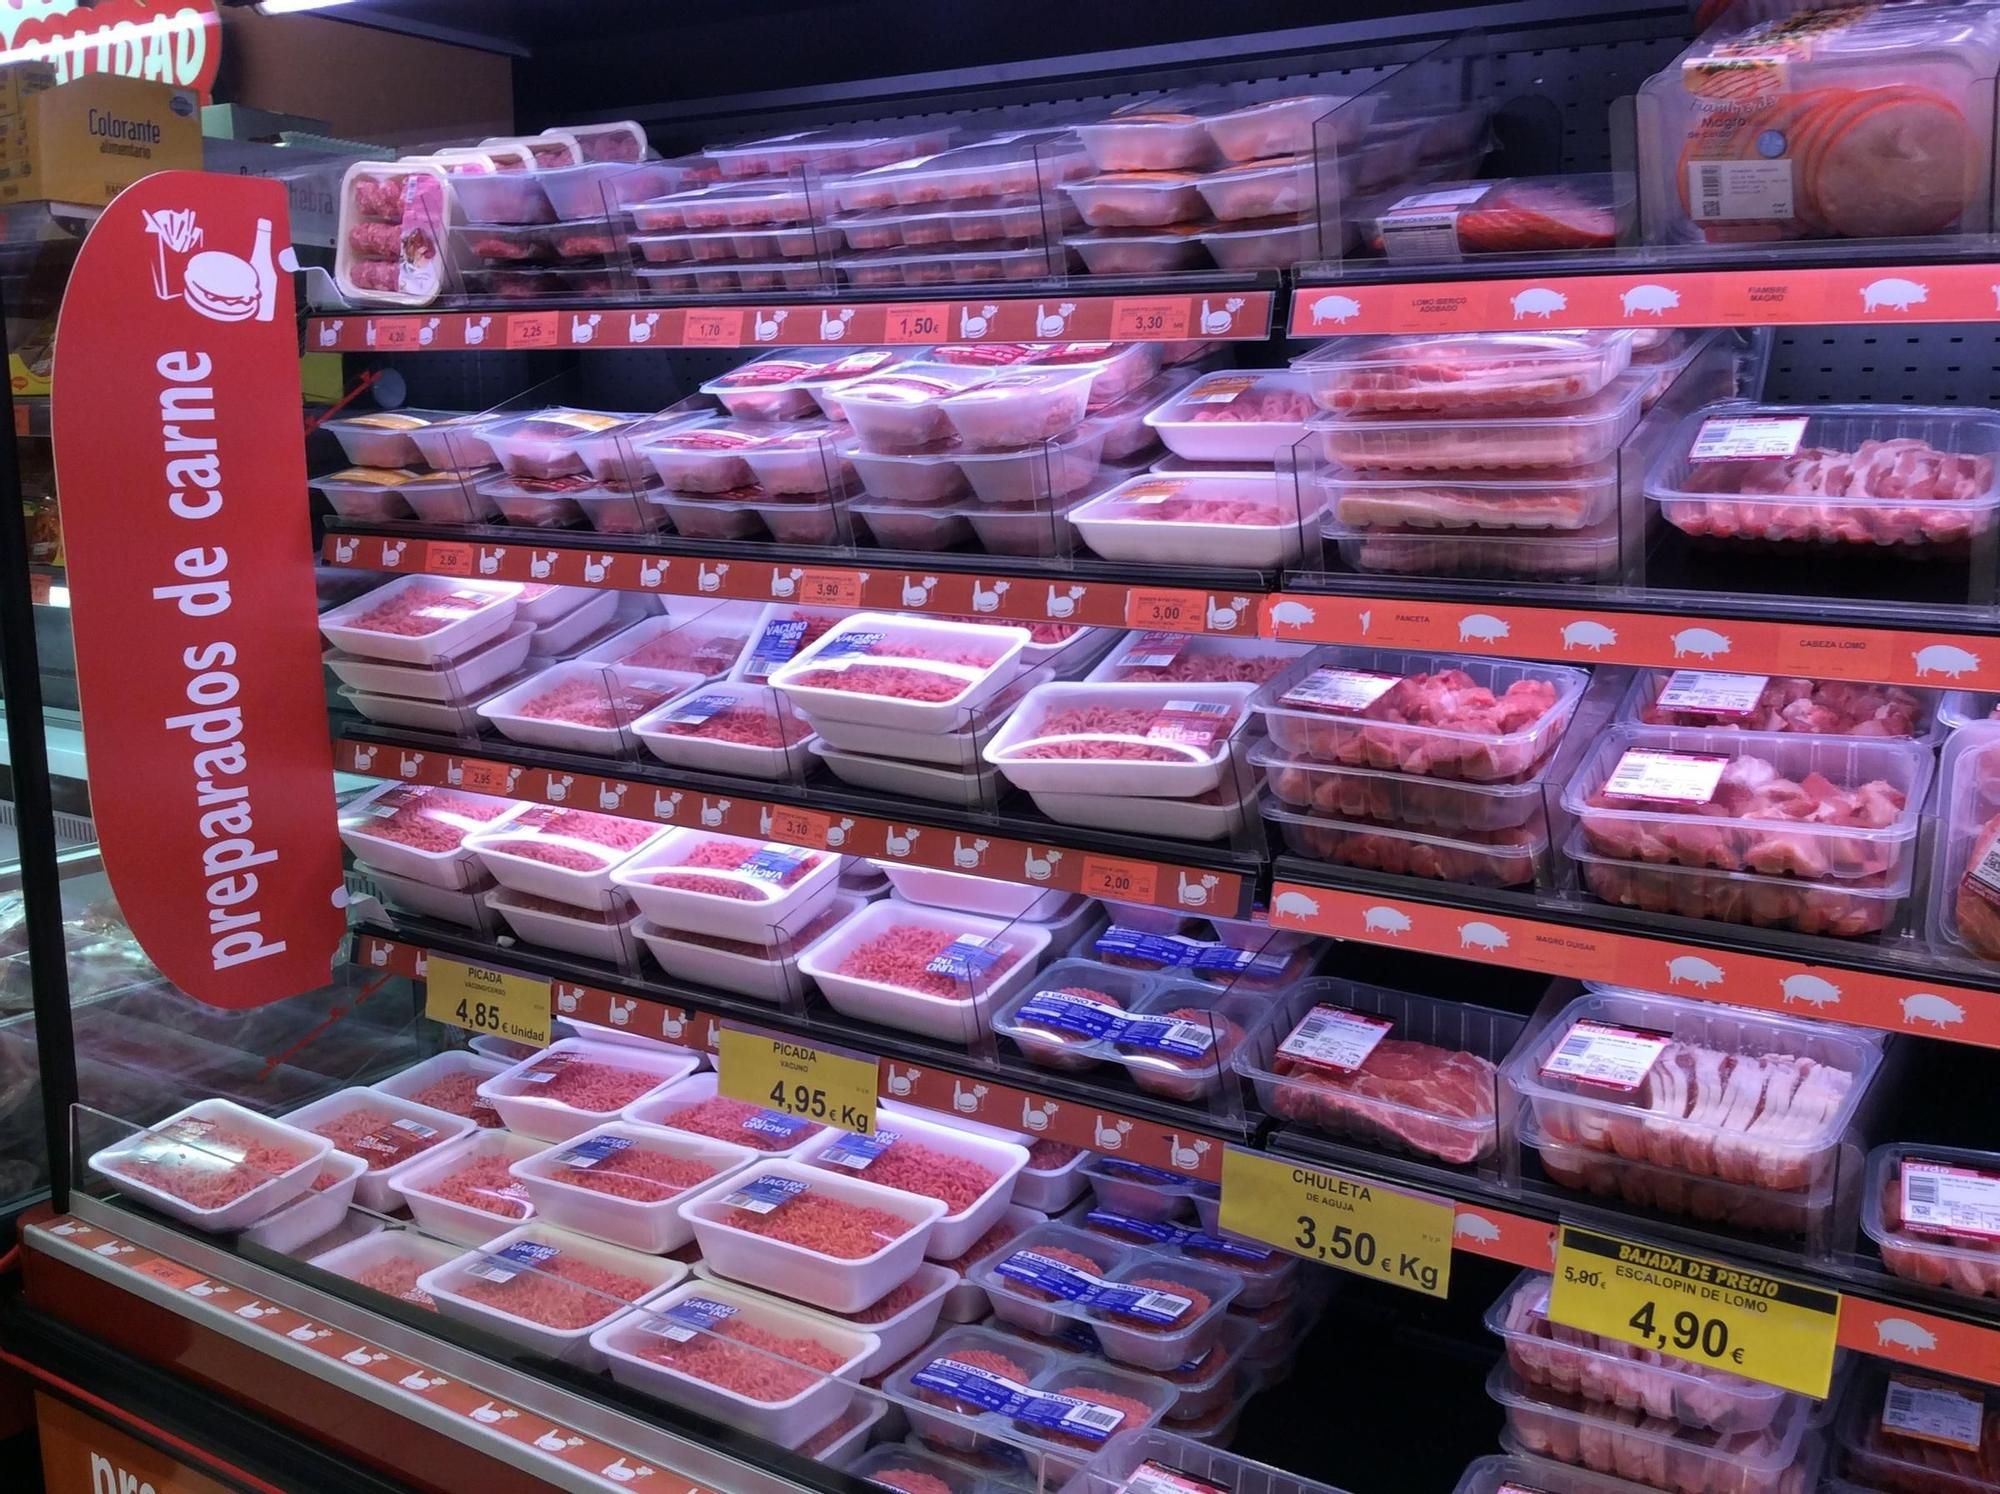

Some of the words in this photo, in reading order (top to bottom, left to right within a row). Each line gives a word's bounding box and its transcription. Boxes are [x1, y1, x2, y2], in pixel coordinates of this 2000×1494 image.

[88, 108, 160, 144] Colorante
[100, 141, 151, 160] alimentario
[1750, 294, 1784, 302] MAGRO
[700, 324, 720, 337] 1,70
[1135, 315, 1163, 331] 3,30
[522, 326, 542, 339] 2,25
[155, 350, 223, 520] carne
[152, 546, 233, 618] de
[817, 583, 839, 596] 3,90
[1152, 606, 1180, 620] 3,00
[766, 620, 808, 637] VACUNO
[1799, 639, 1837, 649] CABEZA
[1838, 641, 1866, 650] LOMO
[165, 639, 287, 972] preparados
[786, 820, 808, 836] 3,10
[1103, 875, 1130, 890] 2,00
[1535, 935, 1565, 946] MAGRO
[468, 967, 503, 985] PICADA
[1051, 991, 1089, 1005] VACUNO
[1141, 1015, 1182, 1025] VACUNO
[455, 998, 499, 1031] 4,85
[511, 1025, 544, 1042] Unidad
[773, 1041, 817, 1063] PICADA
[780, 1060, 809, 1073] VACUNO
[770, 1080, 826, 1118] 4,95
[842, 1104, 868, 1134] Kg
[758, 1176, 810, 1190] VACUNO
[1292, 1169, 1372, 1202] CHULETA
[1306, 1193, 1320, 1204] DE
[1321, 1196, 1355, 1213] AGUJA
[509, 1243, 561, 1256] VACUNO
[1295, 1215, 1377, 1267] 3,50
[1399, 1253, 1439, 1291] Kg
[1031, 1253, 1067, 1270] VACUNO
[1116, 1283, 1155, 1295] VACUNO
[1618, 1244, 1683, 1275] BAJADA
[1687, 1262, 1713, 1281] DE
[1715, 1270, 1780, 1298] PRECIO
[1615, 1264, 1697, 1296] ESCALOPIN
[1701, 1286, 1720, 1302] DE
[1724, 1292, 1768, 1315] LOMO
[682, 1299, 738, 1314] VACUNO
[949, 1361, 988, 1377] VACUNO
[1041, 1392, 1084, 1407] VACUNO
